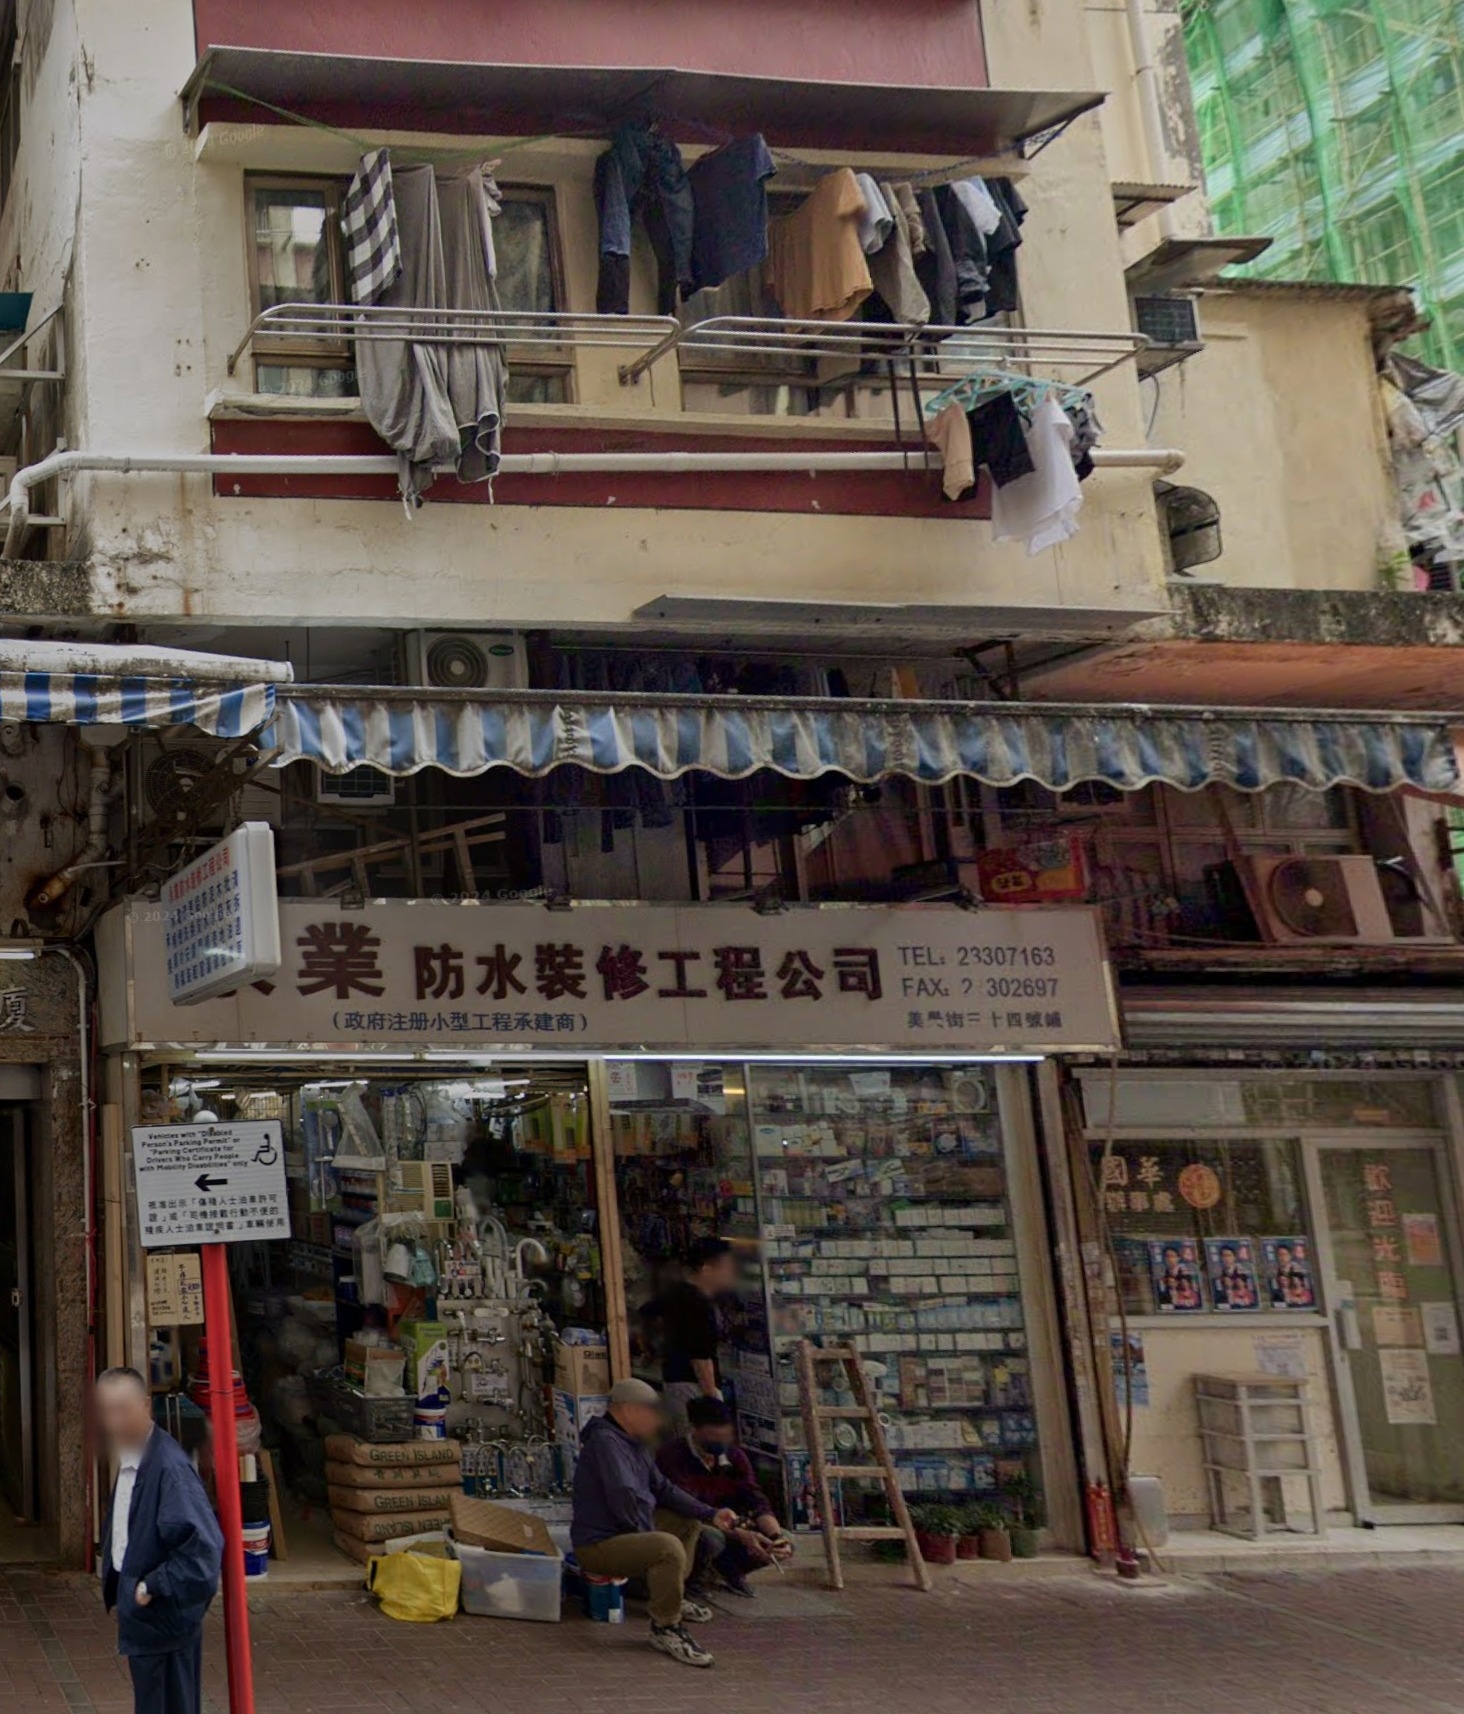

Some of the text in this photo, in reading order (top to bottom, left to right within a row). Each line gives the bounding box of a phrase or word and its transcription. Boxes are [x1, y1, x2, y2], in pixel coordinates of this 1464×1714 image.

[898, 946, 1056, 967] TEL: 23307163
[902, 978, 950, 997] FAX:
[180, 1131, 197, 1139] with
[174, 1138, 202, 1147] Parking
[182, 1145, 221, 1154] Certificate
[146, 1156, 173, 1164] Drivers
[192, 1154, 213, 1162] Carry
[214, 1152, 240, 1160] People
[156, 1163, 187, 1172] Mobility
[233, 1160, 249, 1168] only
[370, 1448, 454, 1462] GREEN ISLAND
[374, 1494, 451, 1509] GREEN ISLAN
